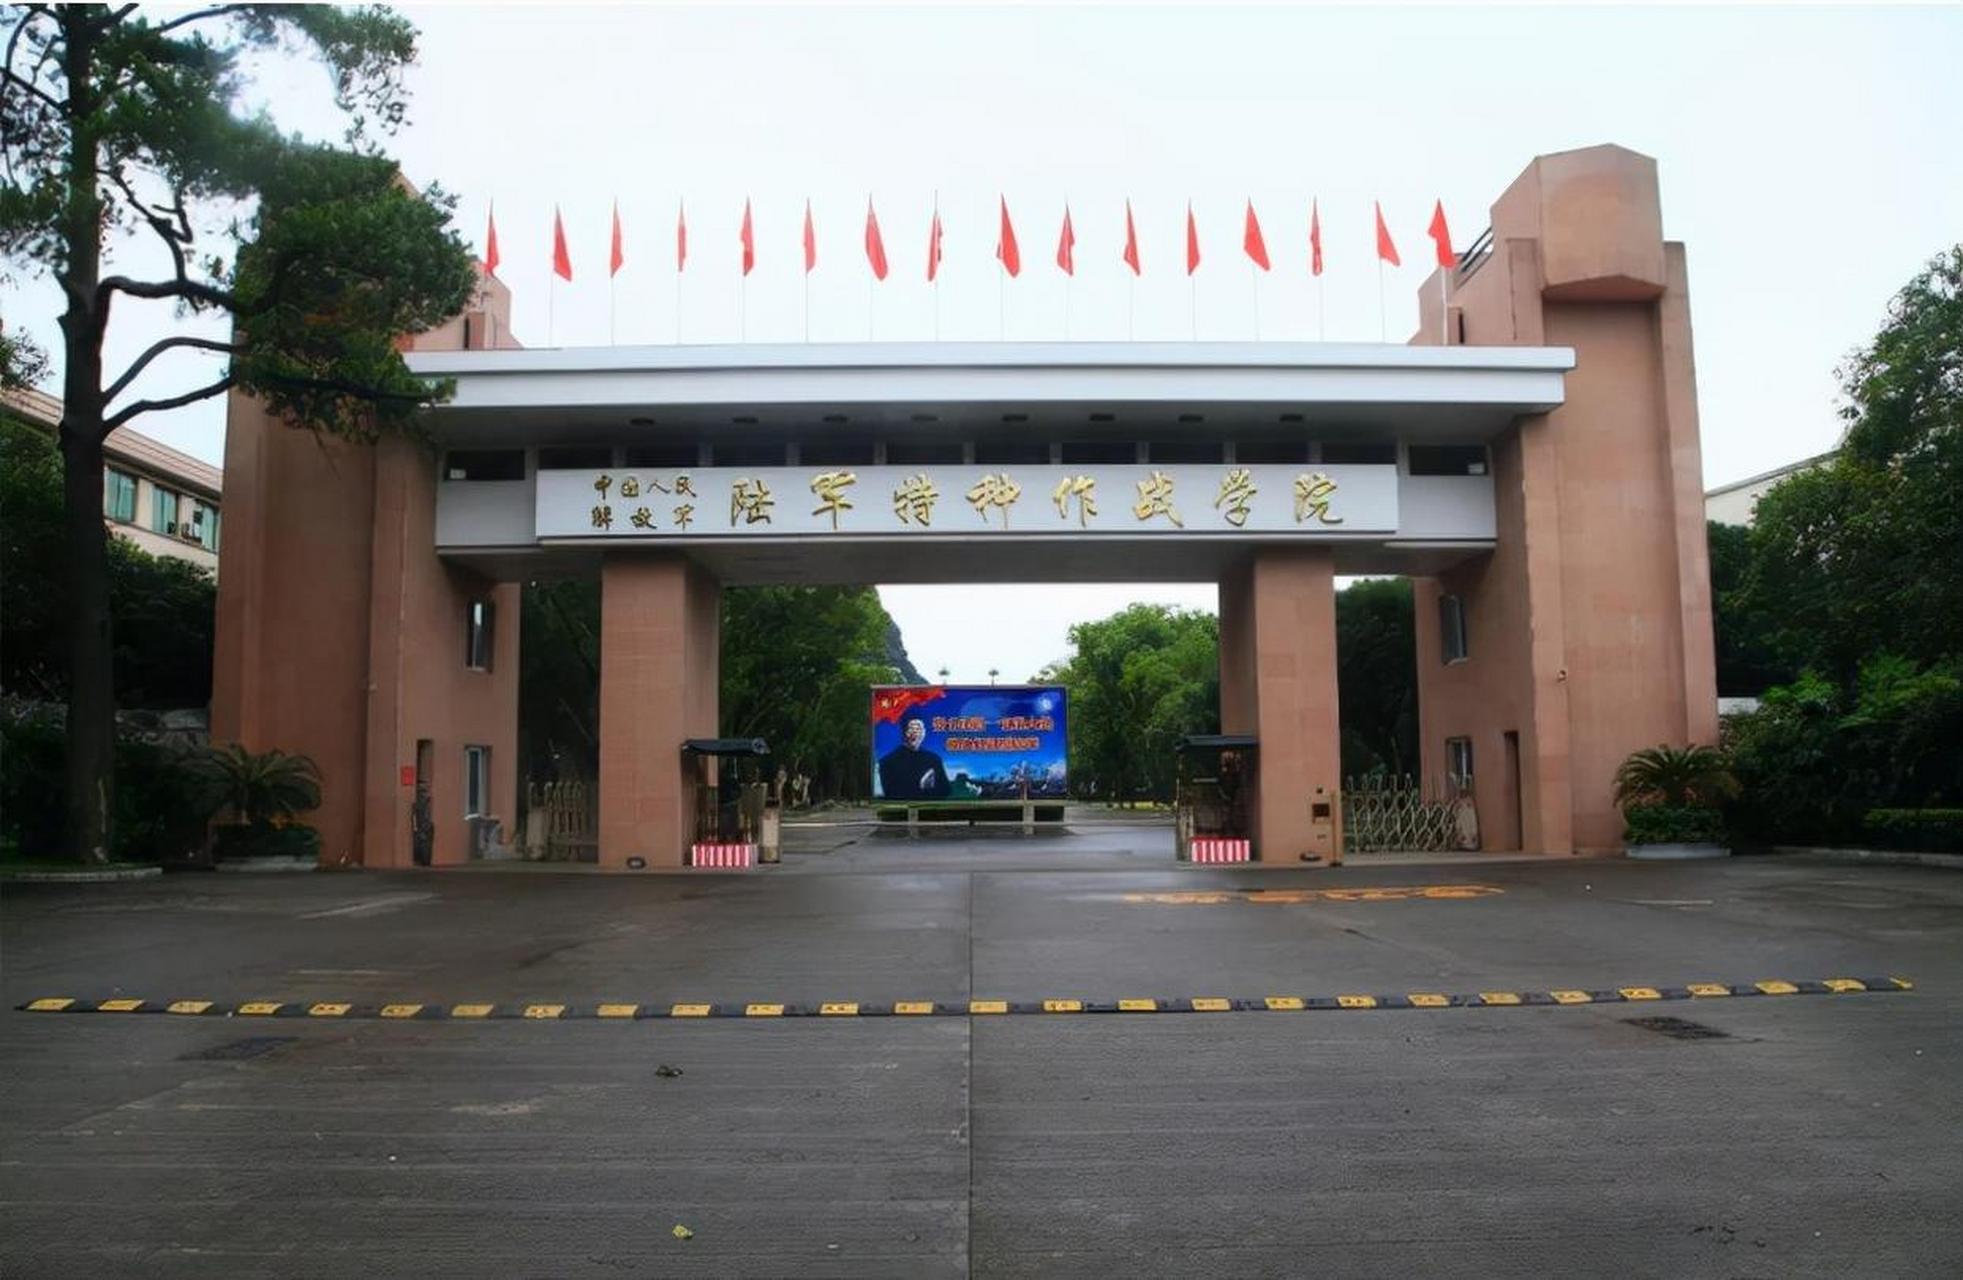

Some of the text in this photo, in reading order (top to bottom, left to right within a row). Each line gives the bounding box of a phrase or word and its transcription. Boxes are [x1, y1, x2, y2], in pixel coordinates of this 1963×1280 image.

[594, 475, 697, 500] 中国人民
[731, 468, 1343, 529] 陆军特种作战学院
[591, 503, 694, 531] 解放军
